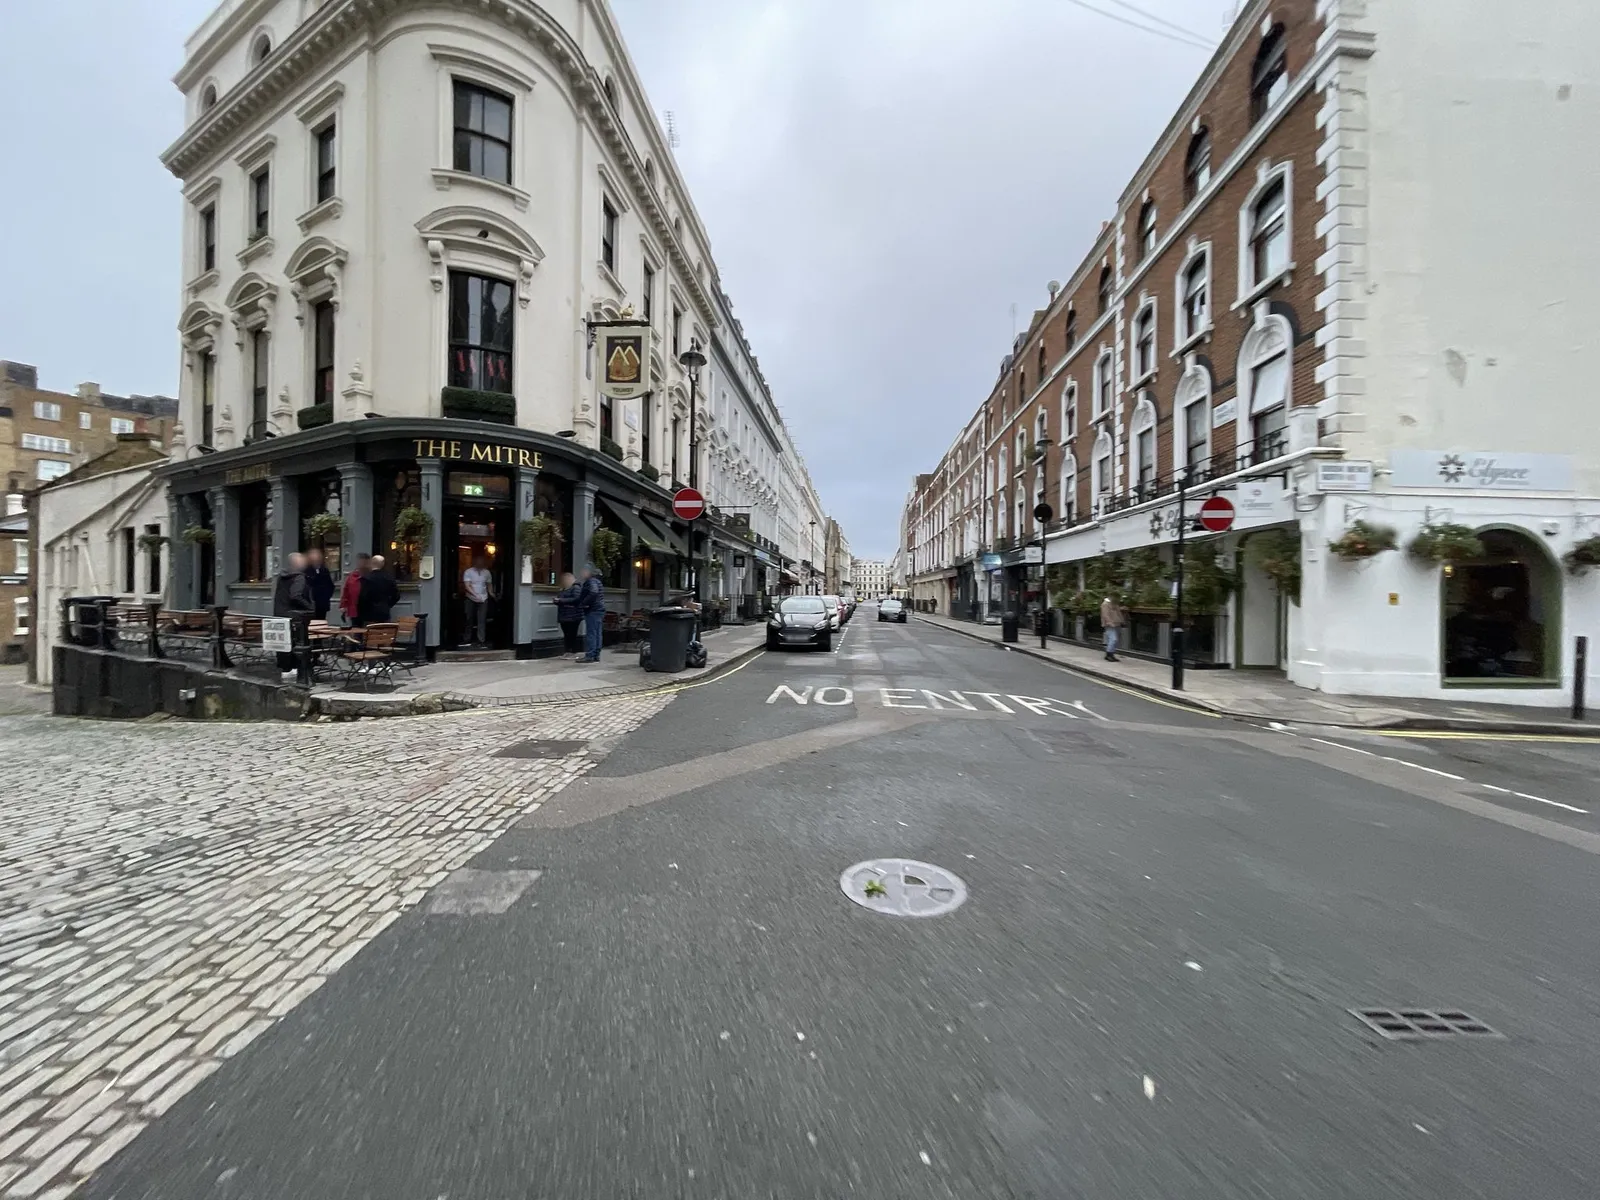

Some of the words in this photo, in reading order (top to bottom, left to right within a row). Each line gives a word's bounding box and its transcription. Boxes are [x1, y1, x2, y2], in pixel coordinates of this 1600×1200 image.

[413, 439, 461, 459] THE
[470, 442, 543, 469] MITRE
[765, 684, 853, 706] NO
[879, 687, 1111, 722] ENTRY
